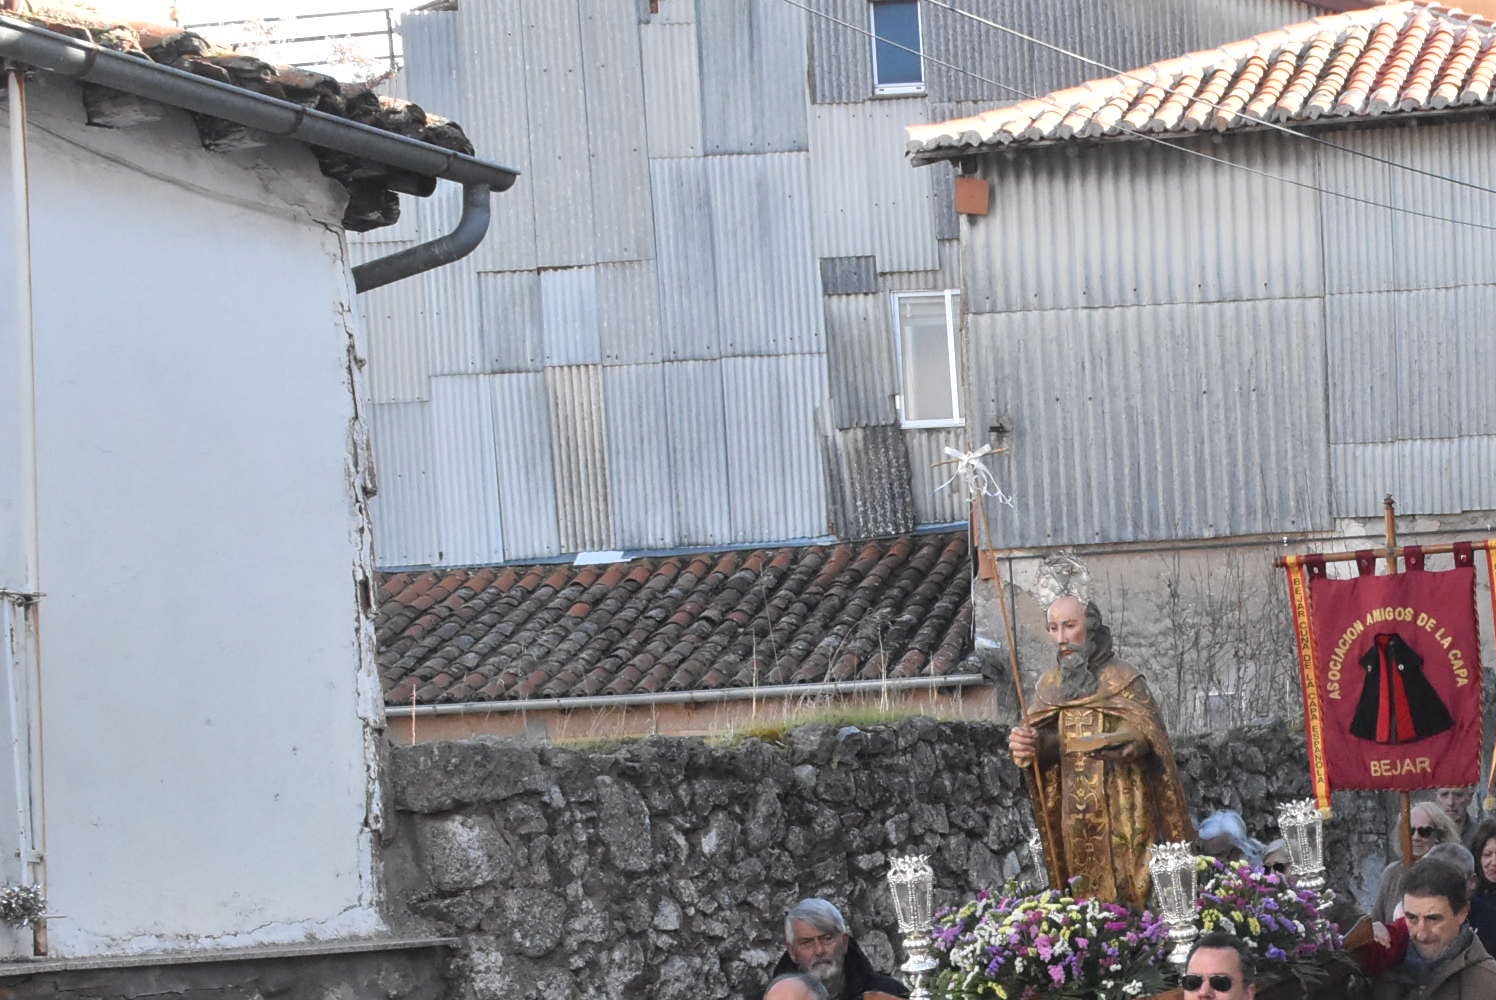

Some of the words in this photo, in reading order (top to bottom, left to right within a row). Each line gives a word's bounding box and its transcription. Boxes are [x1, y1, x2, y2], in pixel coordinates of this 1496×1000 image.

[1294, 578, 1305, 617] BEJAR
[1300, 622, 1311, 649] CUNA
[1304, 655, 1312, 669] DE
[1326, 620, 1364, 699] ASOCIACION
[1366, 606, 1414, 625] AMIGOS
[1416, 612, 1437, 632] DE
[1435, 628, 1452, 649] LA
[1448, 649, 1469, 687] CAPA
[1306, 674, 1315, 688] LA
[1308, 693, 1318, 720] CAPA
[1370, 757, 1432, 776] BEJAR
